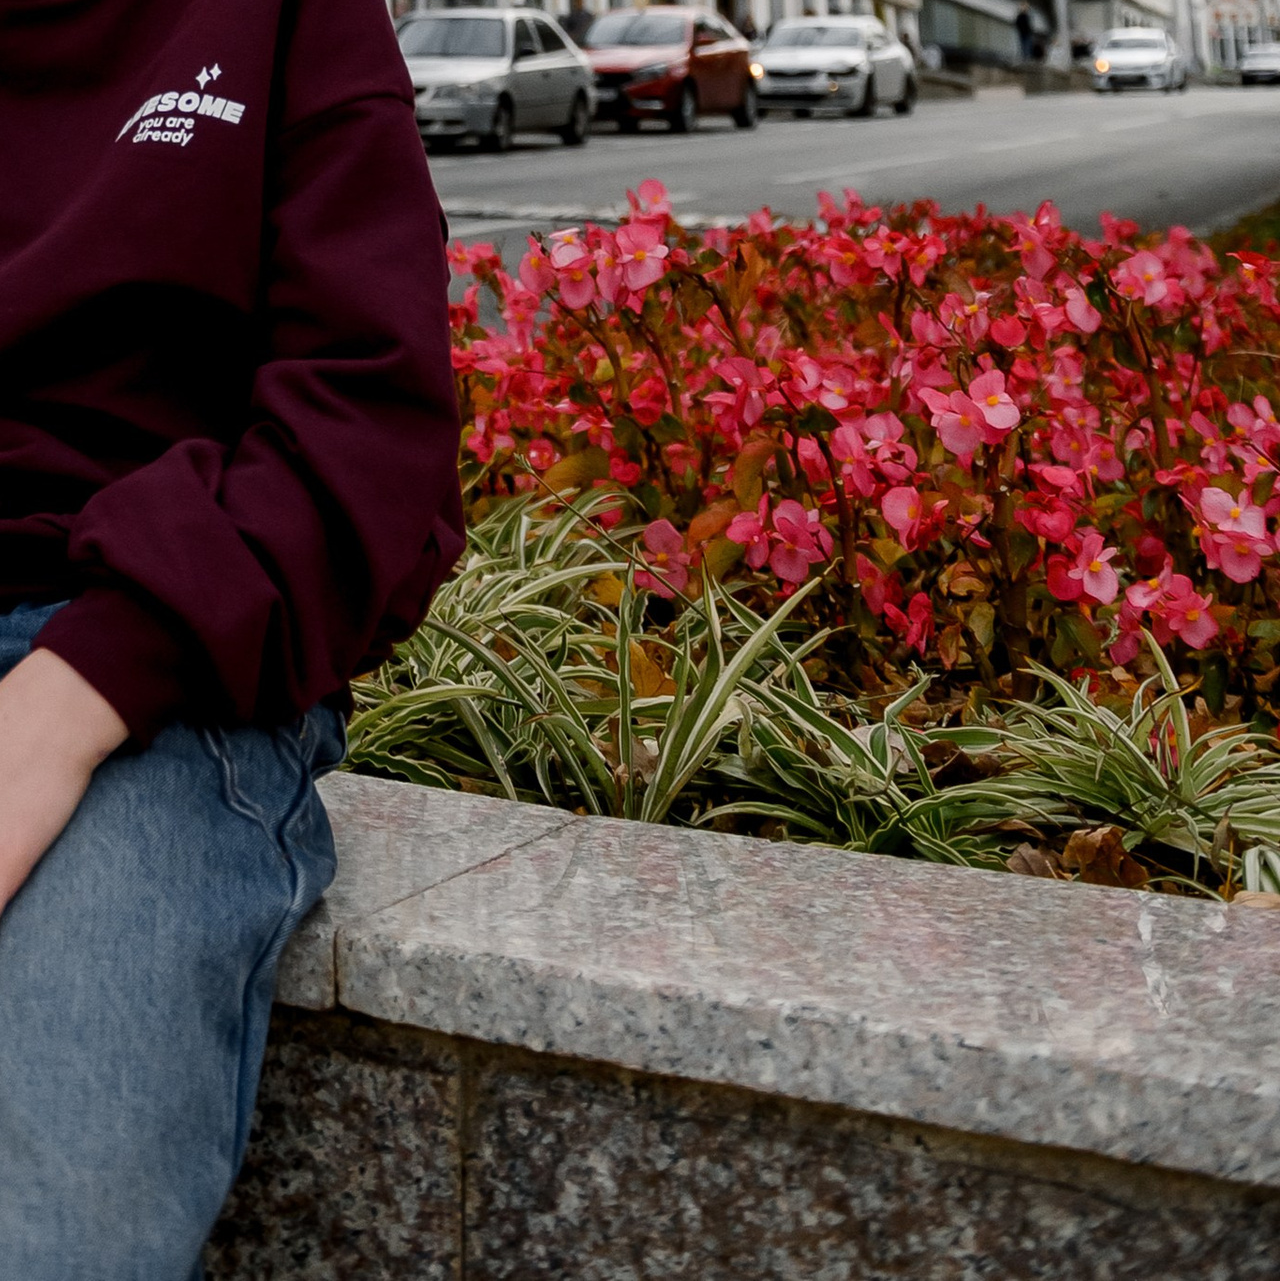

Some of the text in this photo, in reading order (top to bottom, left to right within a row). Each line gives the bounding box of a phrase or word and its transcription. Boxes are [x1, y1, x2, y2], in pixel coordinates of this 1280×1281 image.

[139, 117, 195, 132] you are
[133, 128, 194, 147] already
